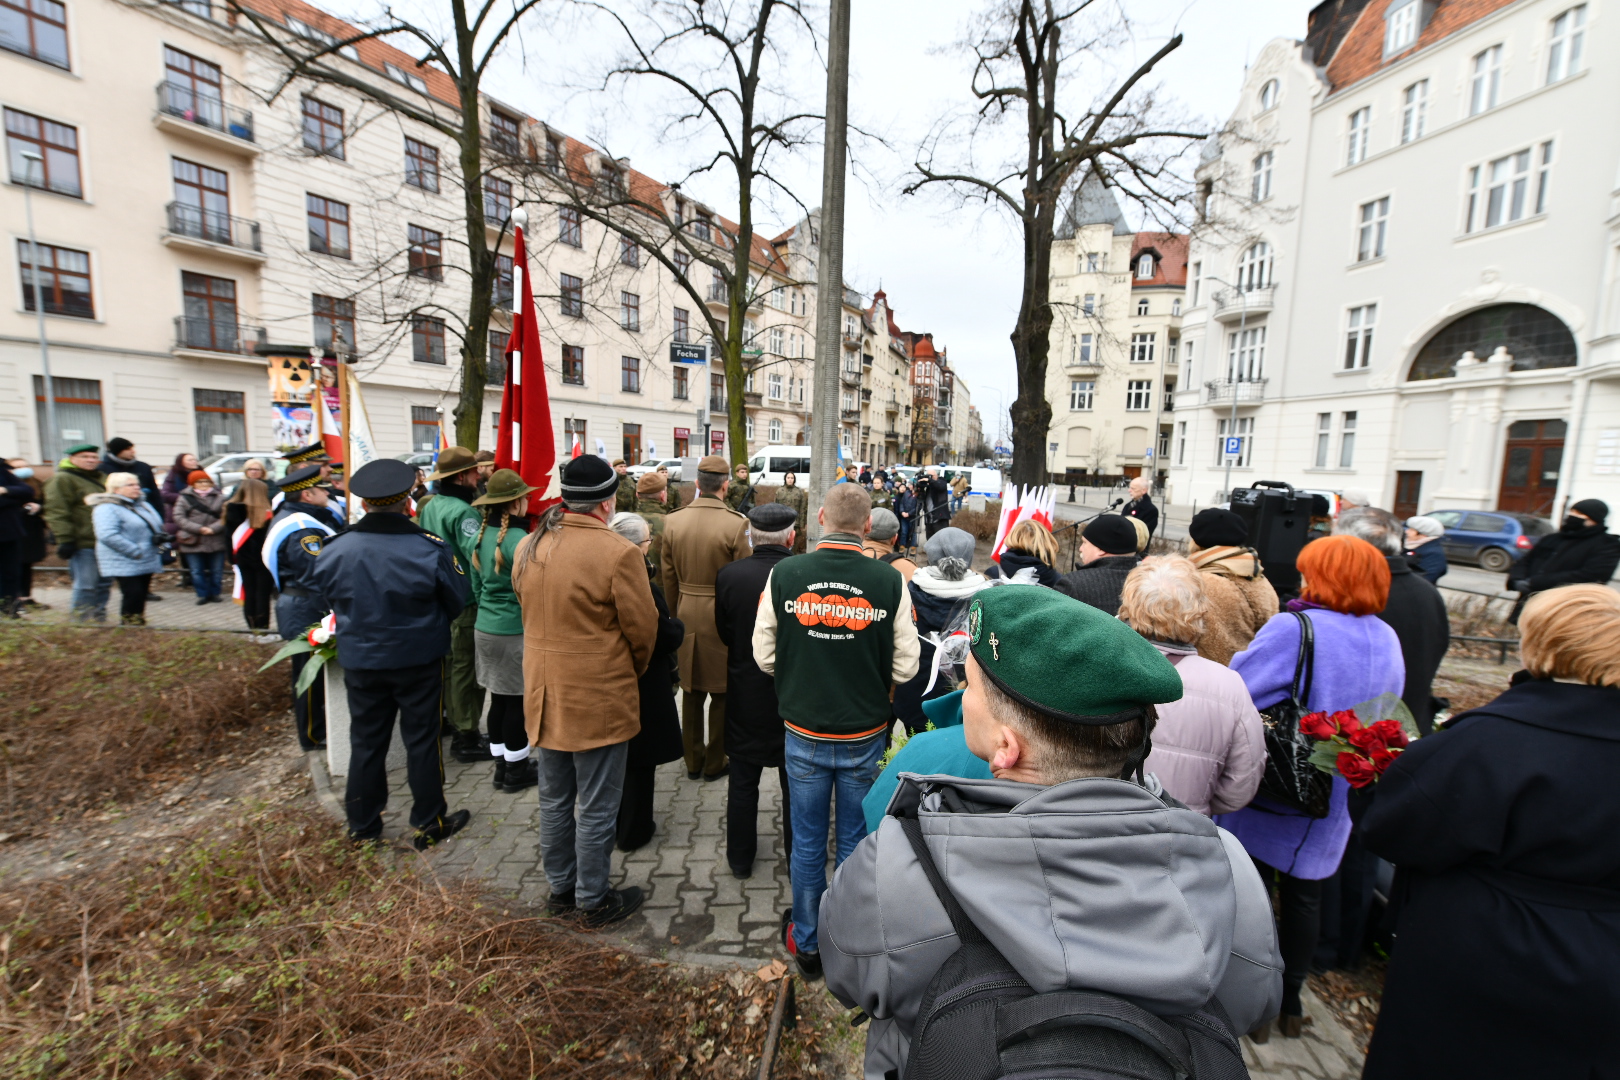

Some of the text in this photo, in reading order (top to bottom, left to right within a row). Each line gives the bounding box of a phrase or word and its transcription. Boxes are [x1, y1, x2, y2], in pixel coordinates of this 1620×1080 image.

[677, 350, 698, 358] Focha
[807, 582, 863, 595] WORLD SERIES MVP
[785, 600, 887, 621] CHAMPIONSHIP
[808, 629, 830, 639] SEASON
